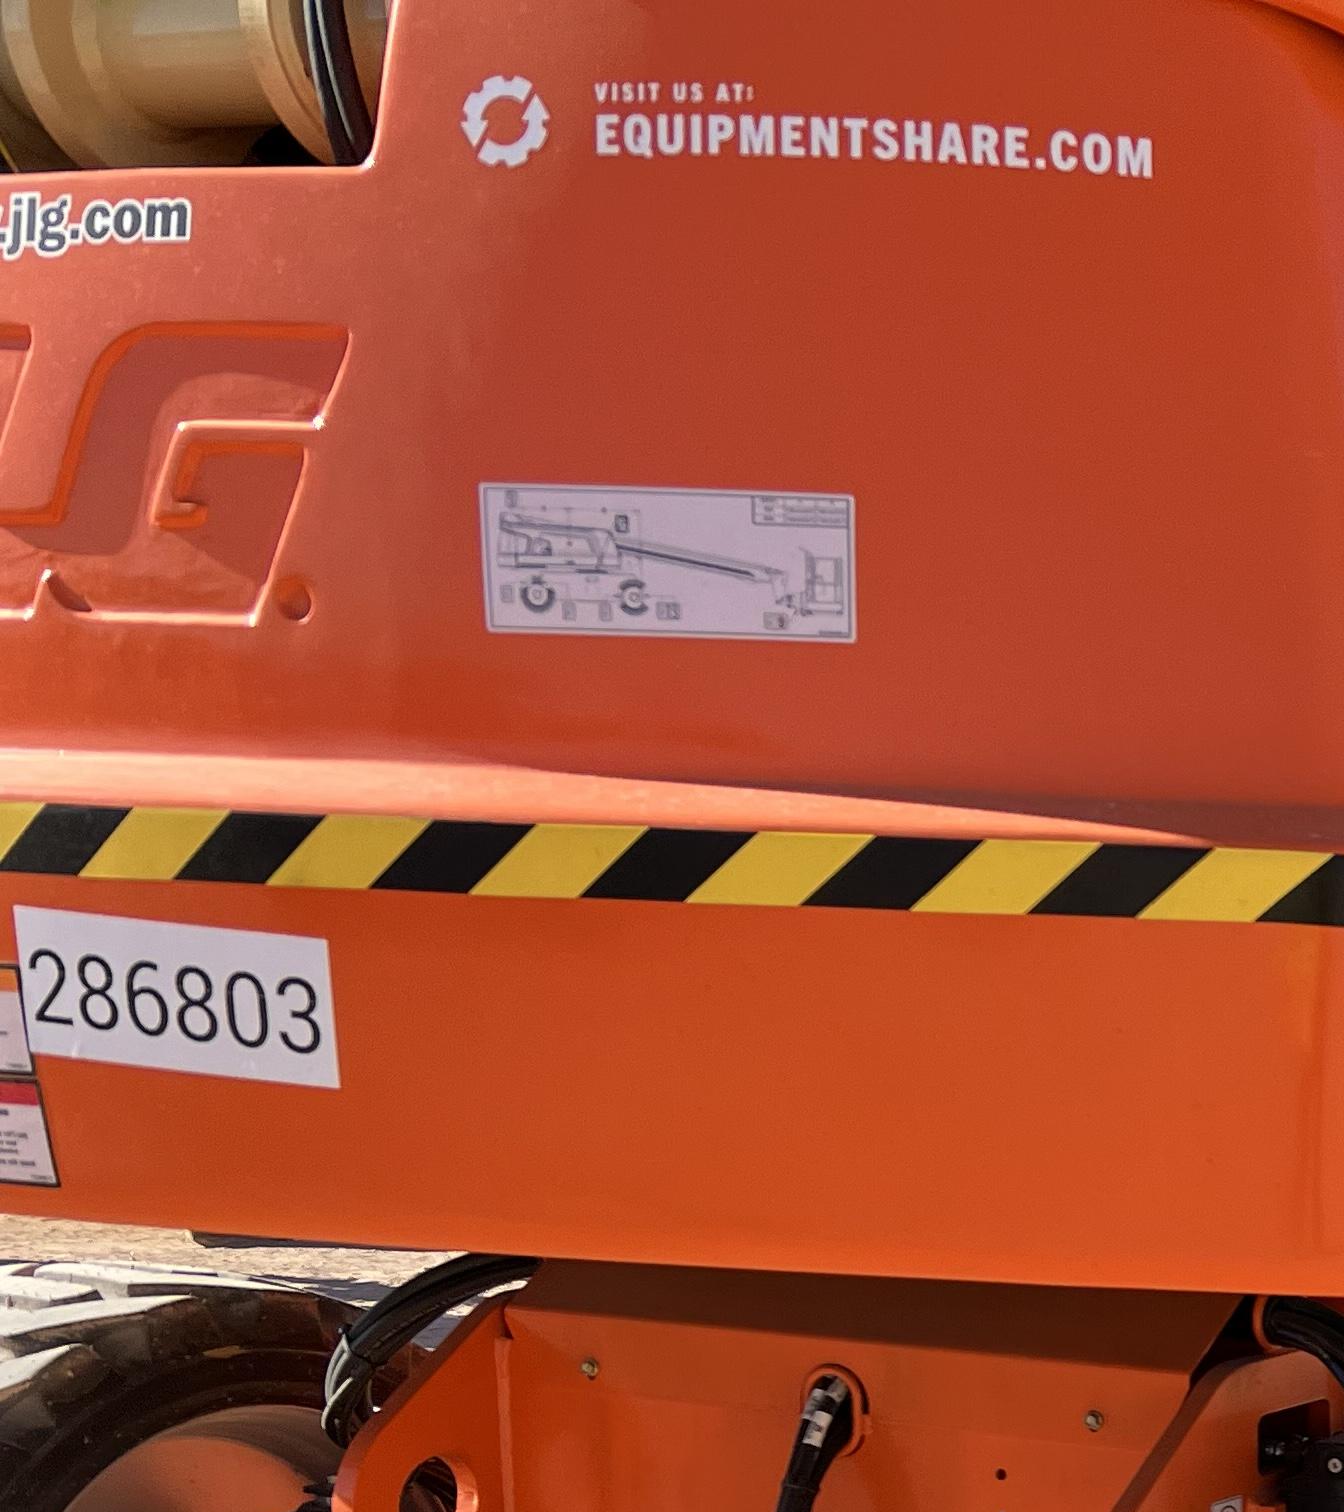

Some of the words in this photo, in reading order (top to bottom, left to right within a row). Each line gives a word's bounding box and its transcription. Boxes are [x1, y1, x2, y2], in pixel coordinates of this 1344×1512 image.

[595, 82, 661, 103] VISIT
[672, 83, 704, 103] US
[715, 83, 755, 103] AT:
[595, 113, 1154, 180] EQUIPMENTSHARE.COM
[28, 947, 322, 1054] 286803
